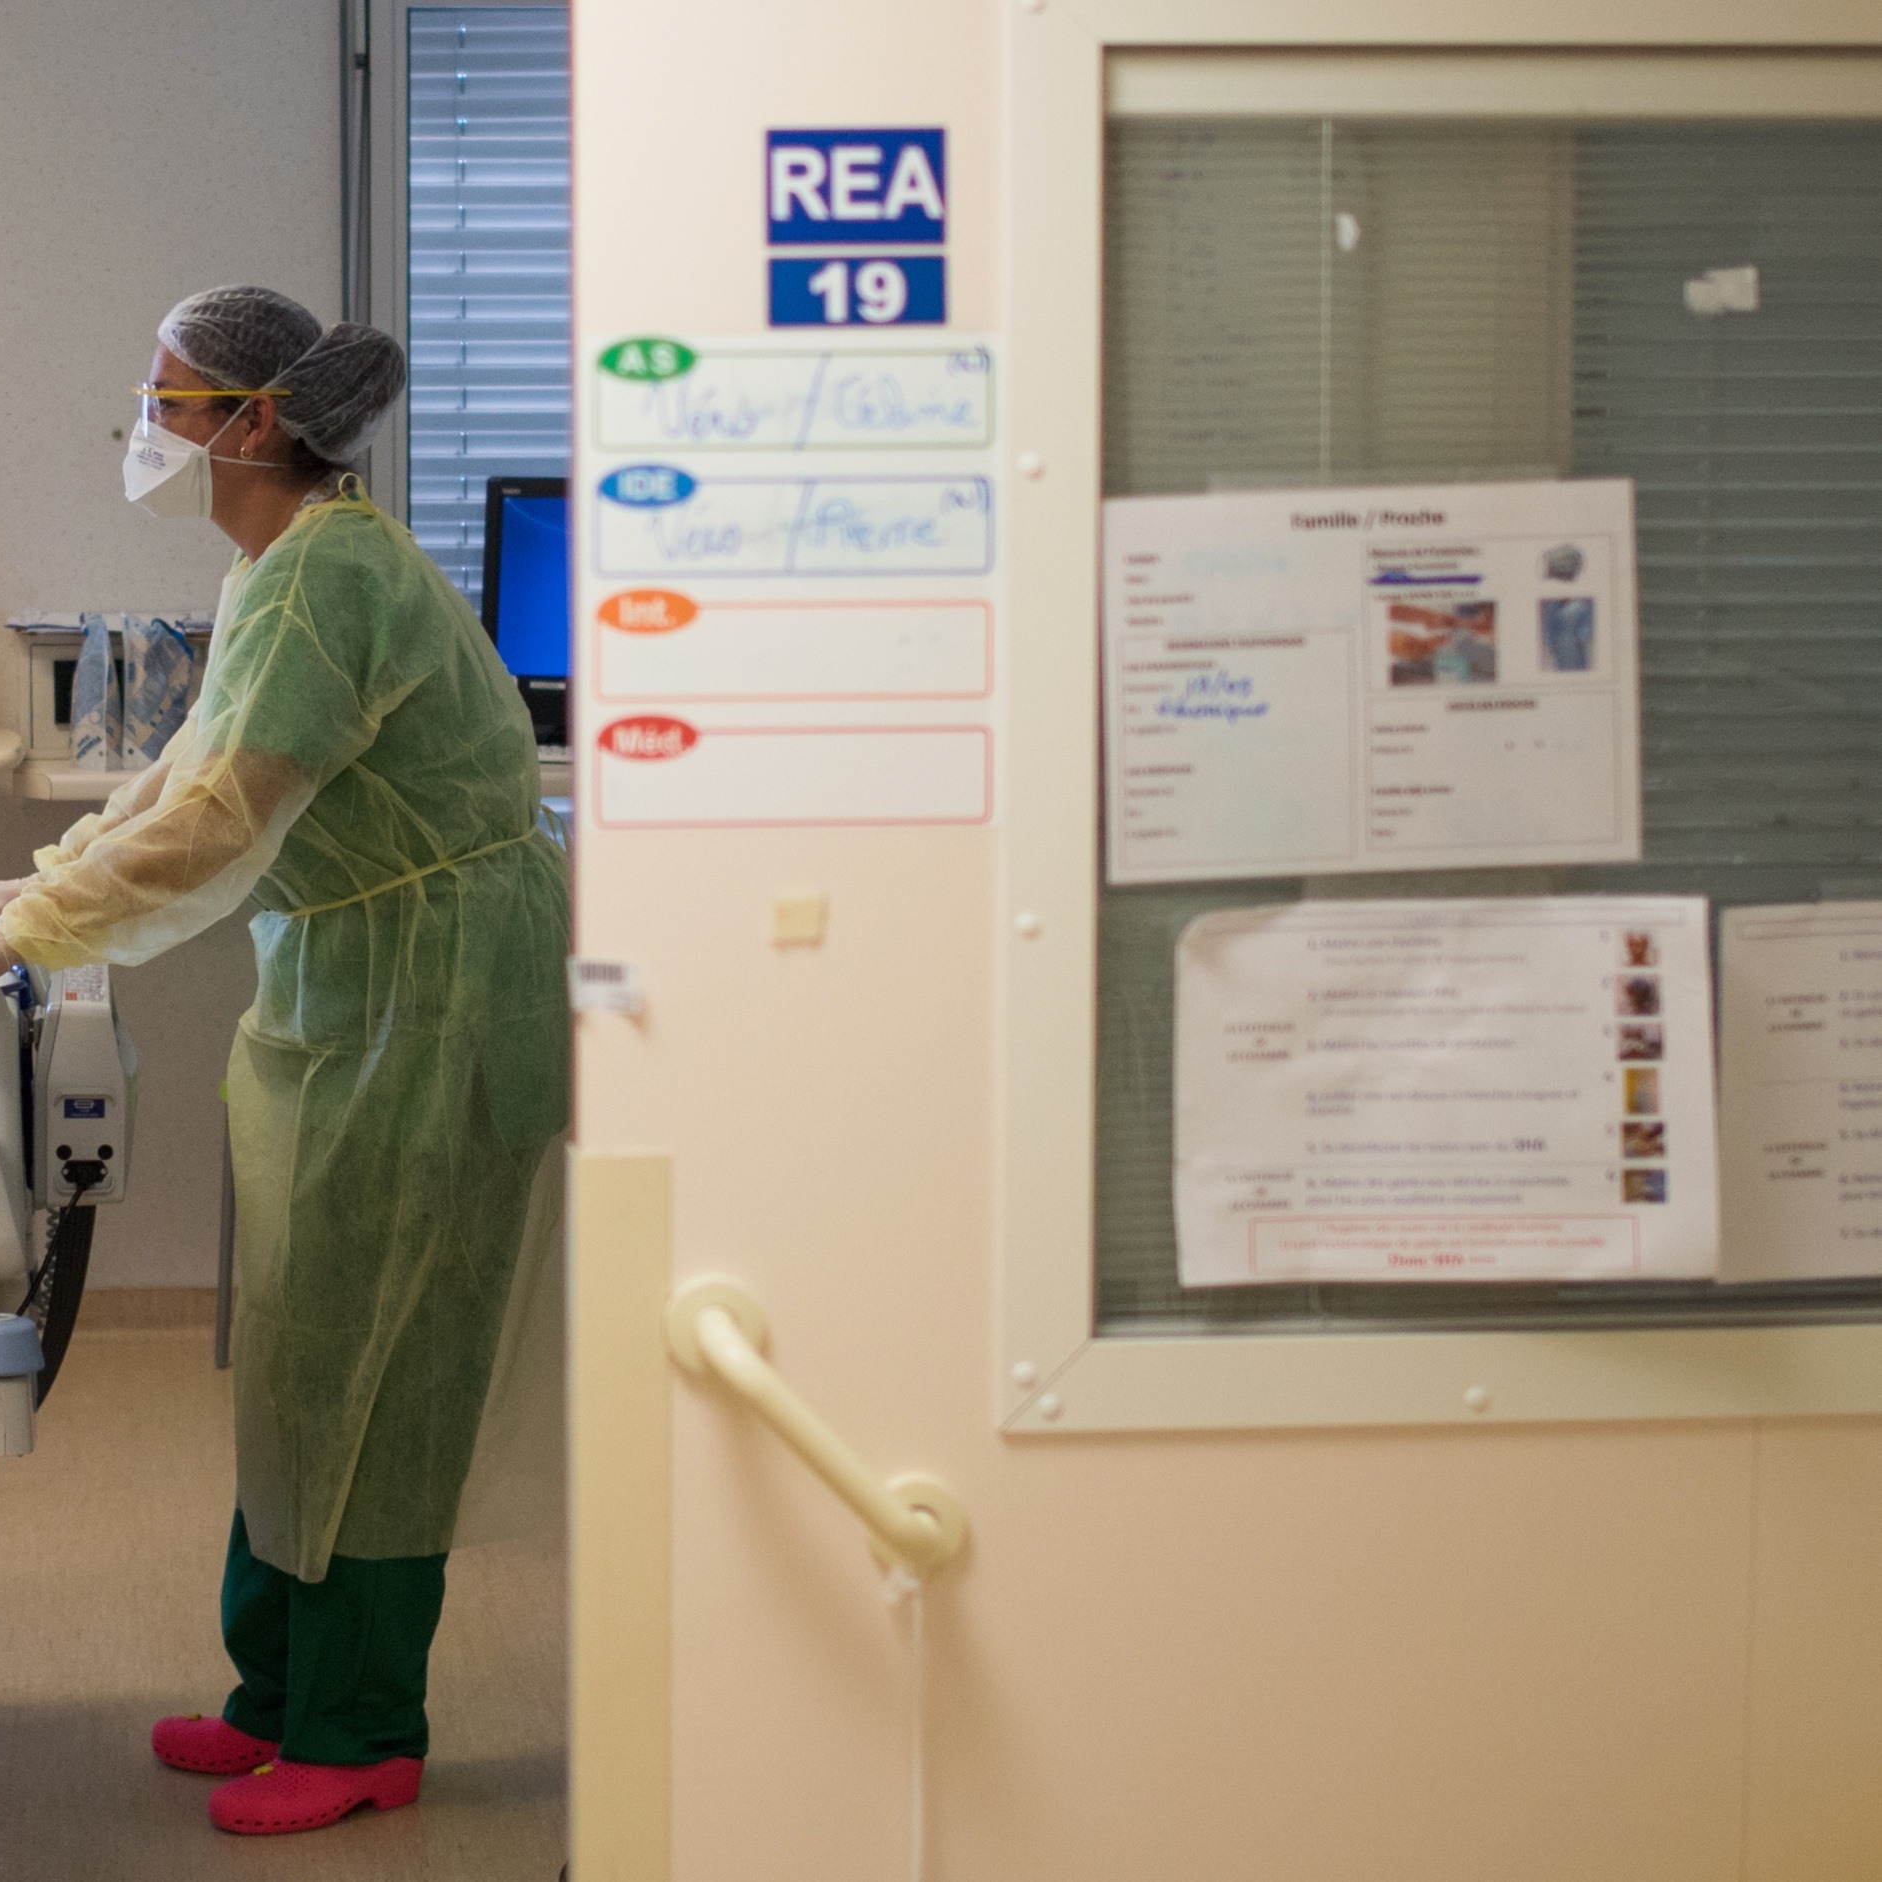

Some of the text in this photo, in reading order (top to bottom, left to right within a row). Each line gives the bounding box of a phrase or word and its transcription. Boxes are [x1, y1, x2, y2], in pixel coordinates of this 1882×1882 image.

[770, 145, 945, 221] REA
[808, 261, 908, 324] 19
[618, 344, 680, 376] AS
[618, 472, 678, 498] IDE
